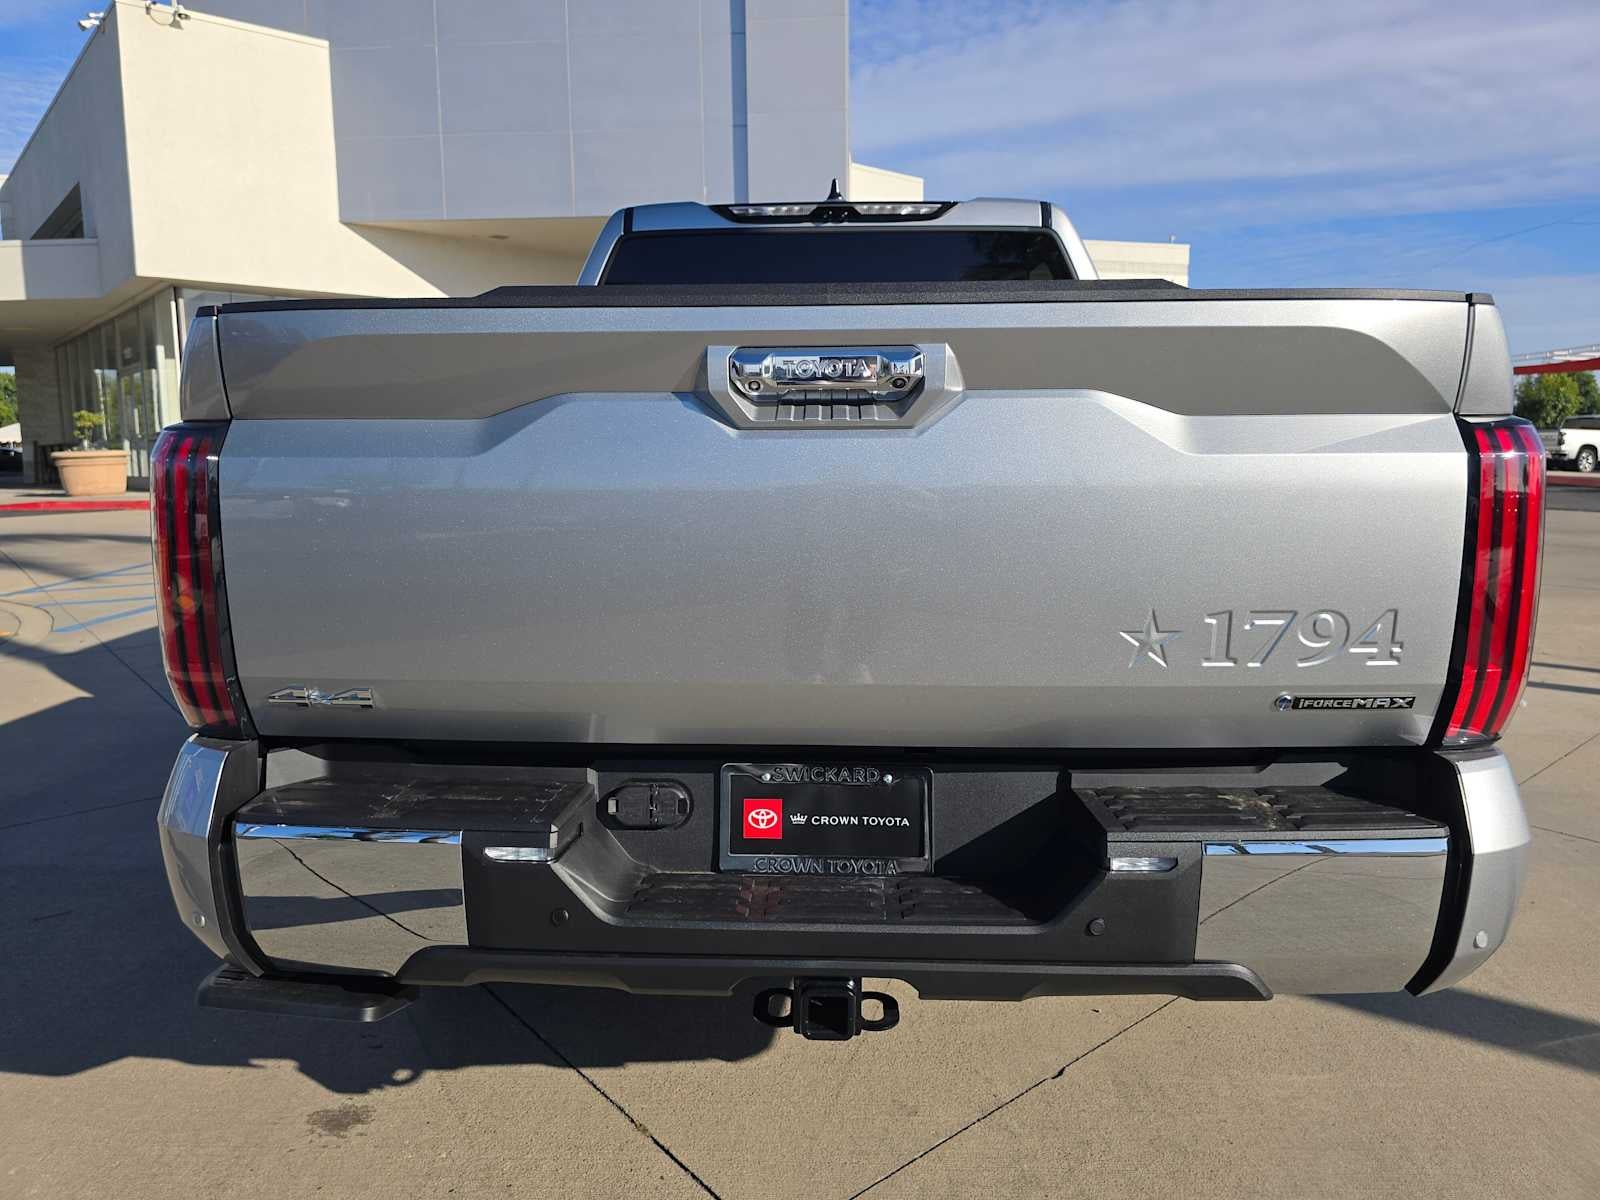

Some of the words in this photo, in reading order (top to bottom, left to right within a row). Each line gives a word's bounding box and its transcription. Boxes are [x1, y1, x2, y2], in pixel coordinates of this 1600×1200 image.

[783, 359, 870, 378] TOYOTA
[1201, 608, 1404, 668] 1794
[772, 767, 880, 783] SWICKARD
[811, 815, 859, 826] CROWN
[862, 816, 910, 827] TOYOTA
[753, 857, 823, 874] CROWN
[827, 858, 898, 876] TOYOTA
